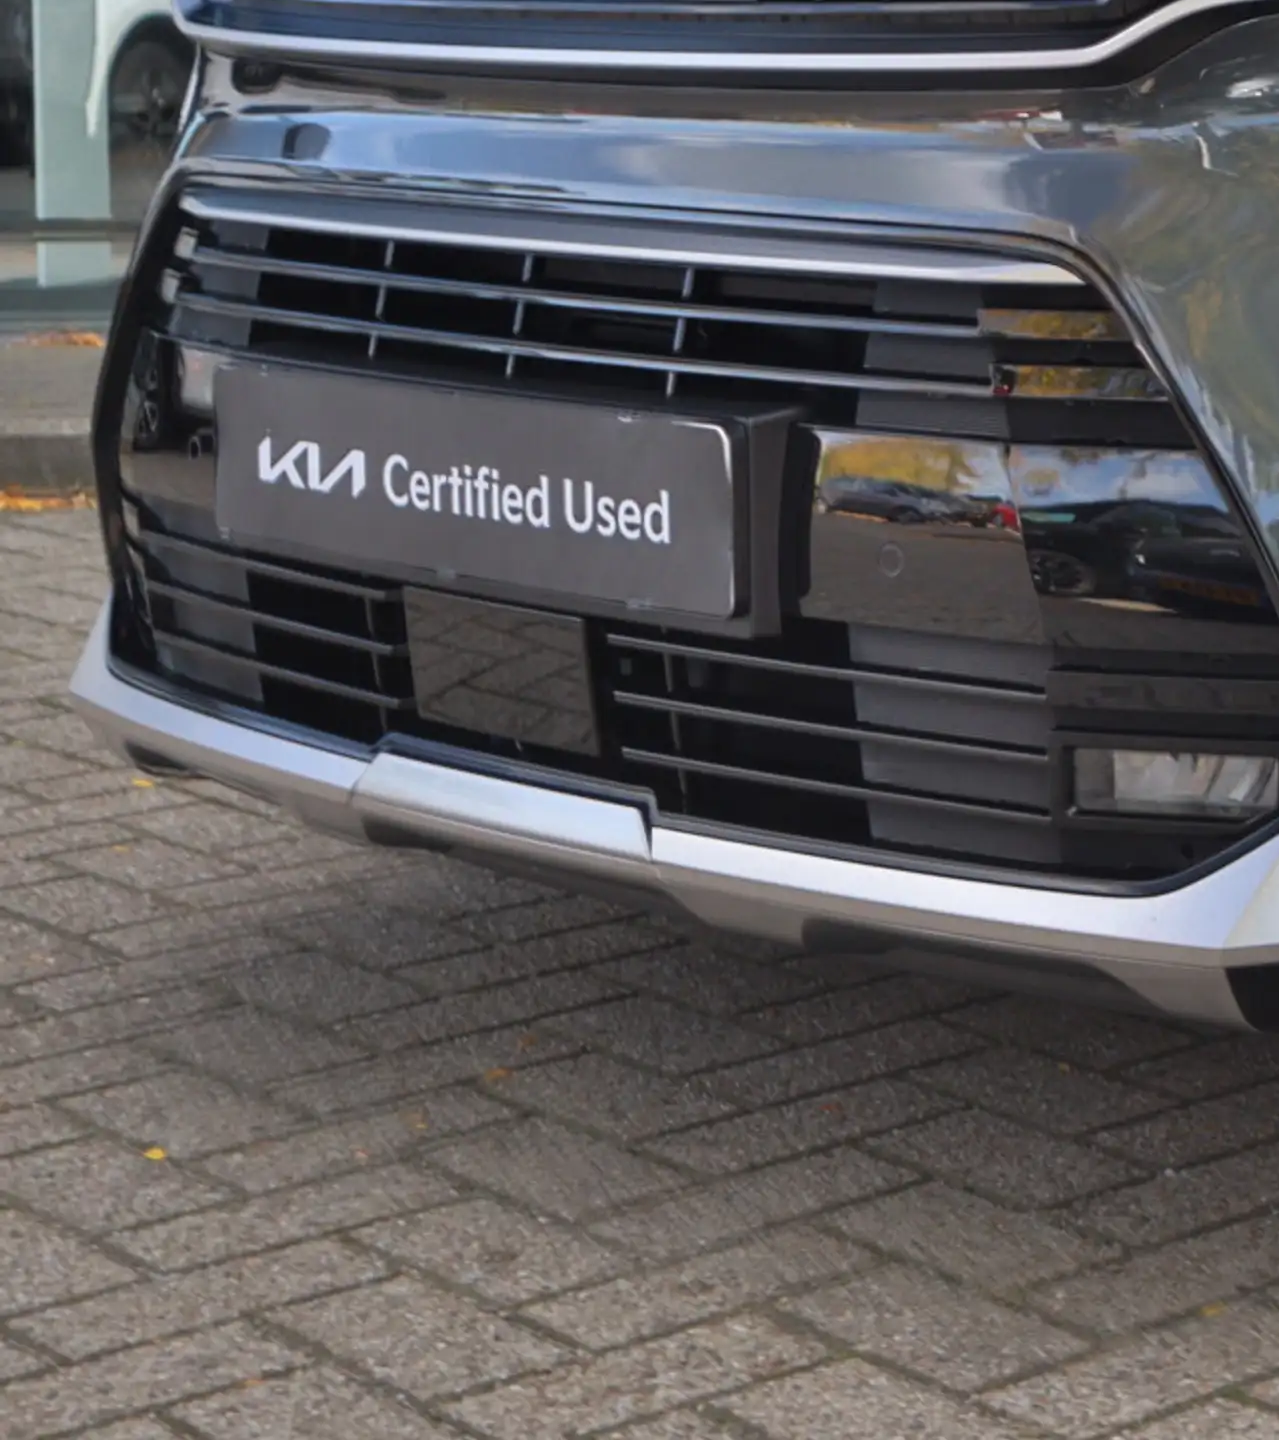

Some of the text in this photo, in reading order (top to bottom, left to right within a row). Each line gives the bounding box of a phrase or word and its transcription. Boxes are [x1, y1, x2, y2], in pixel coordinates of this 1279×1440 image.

[257, 435, 671, 544] KIA Certified Used
